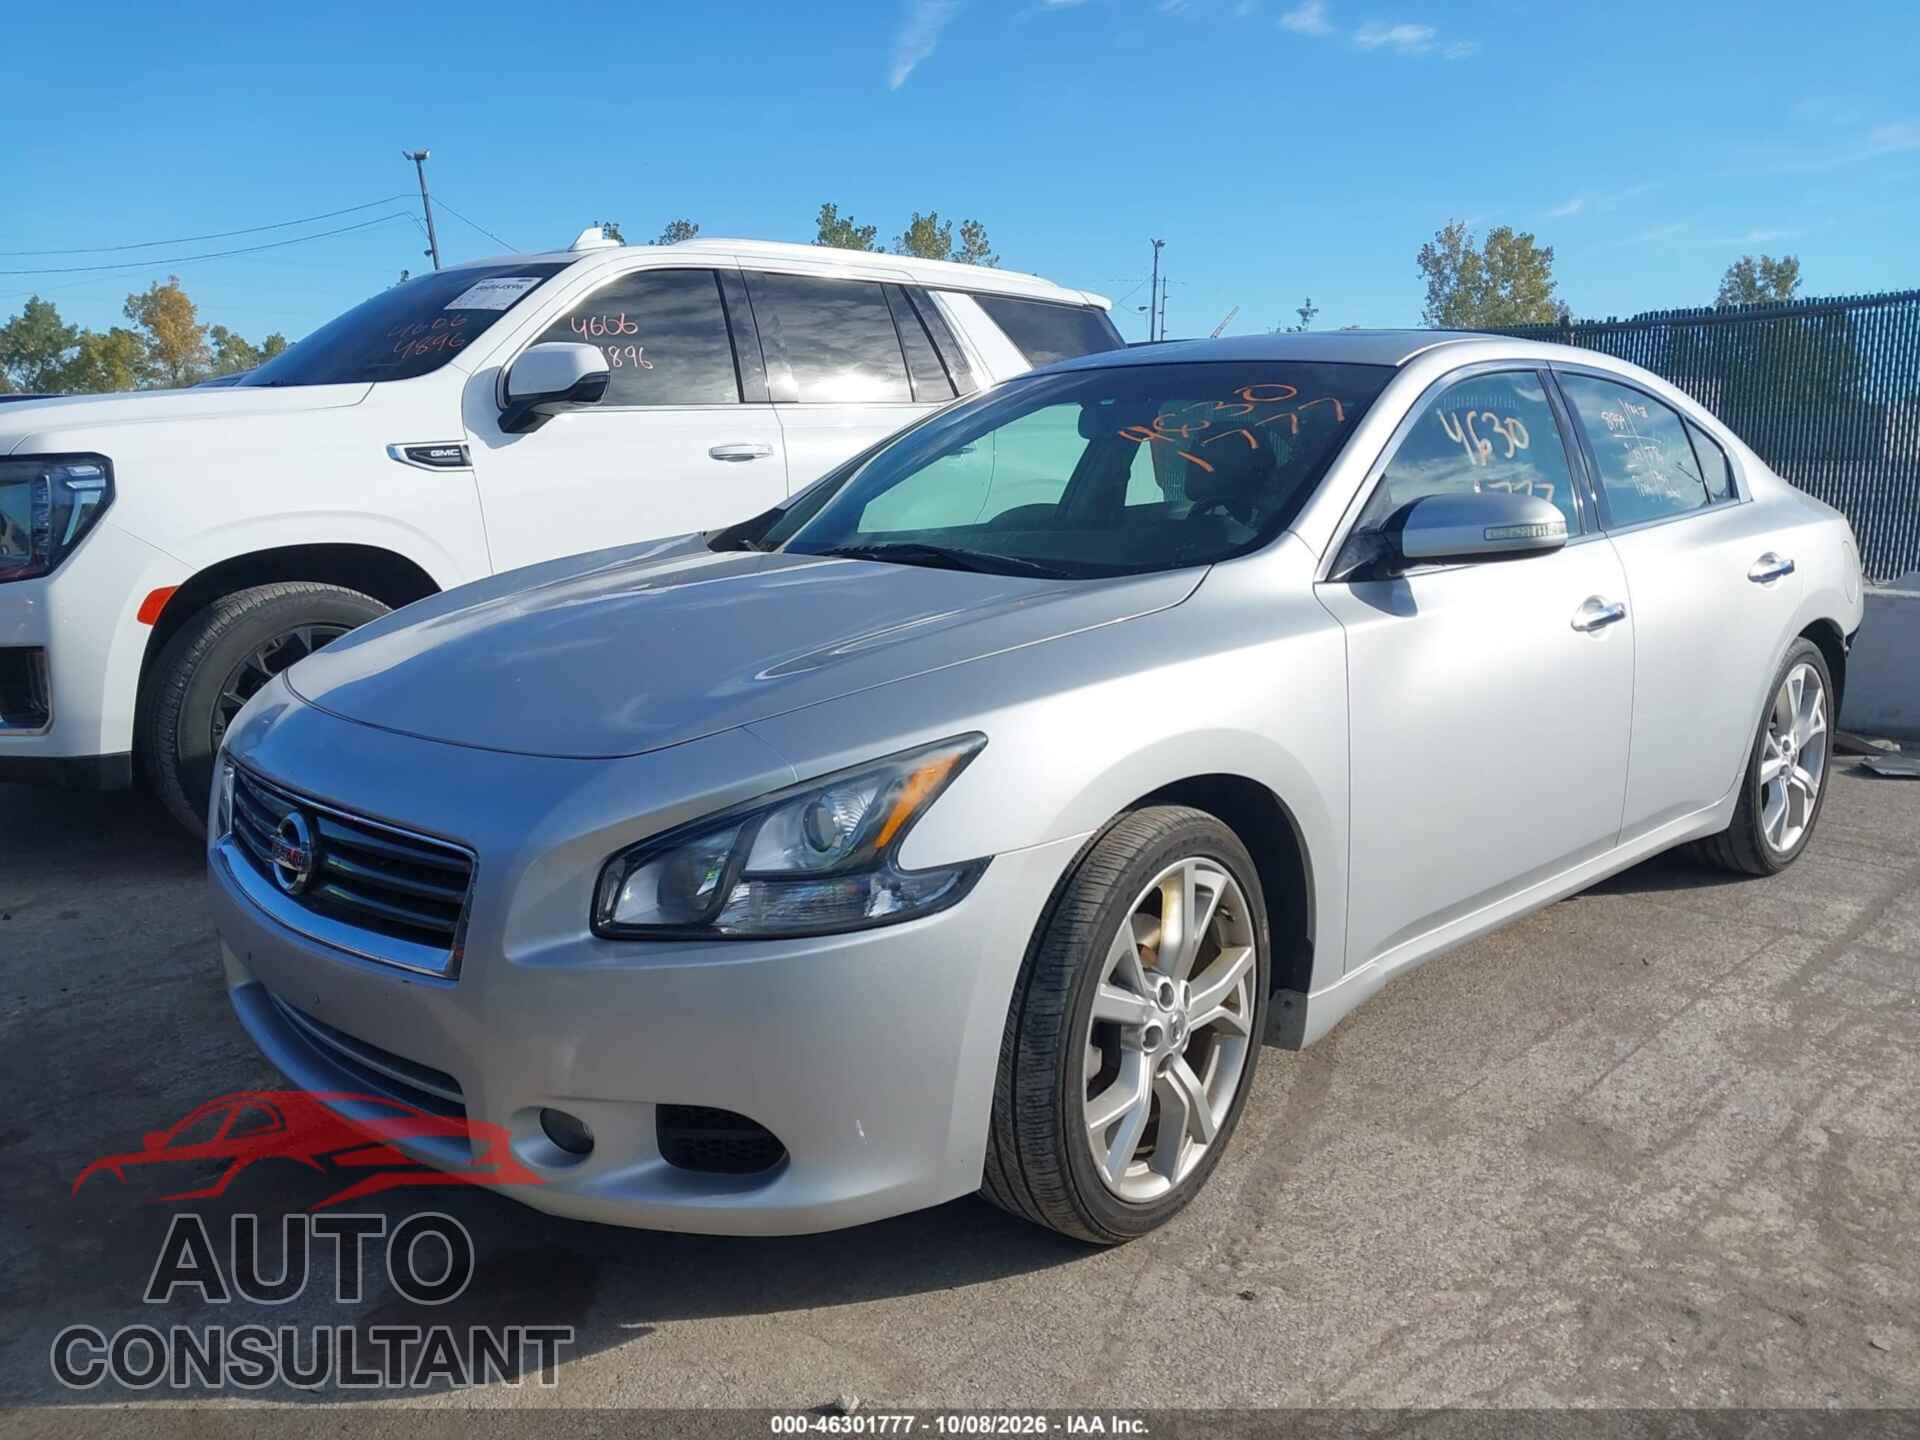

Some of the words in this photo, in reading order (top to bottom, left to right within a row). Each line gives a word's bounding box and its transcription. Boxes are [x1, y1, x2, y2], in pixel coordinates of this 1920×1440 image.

[570, 312, 639, 341] 4606
[600, 345, 654, 370] 896
[1436, 409, 1530, 467] 4630
[430, 448, 461, 457] GMC
